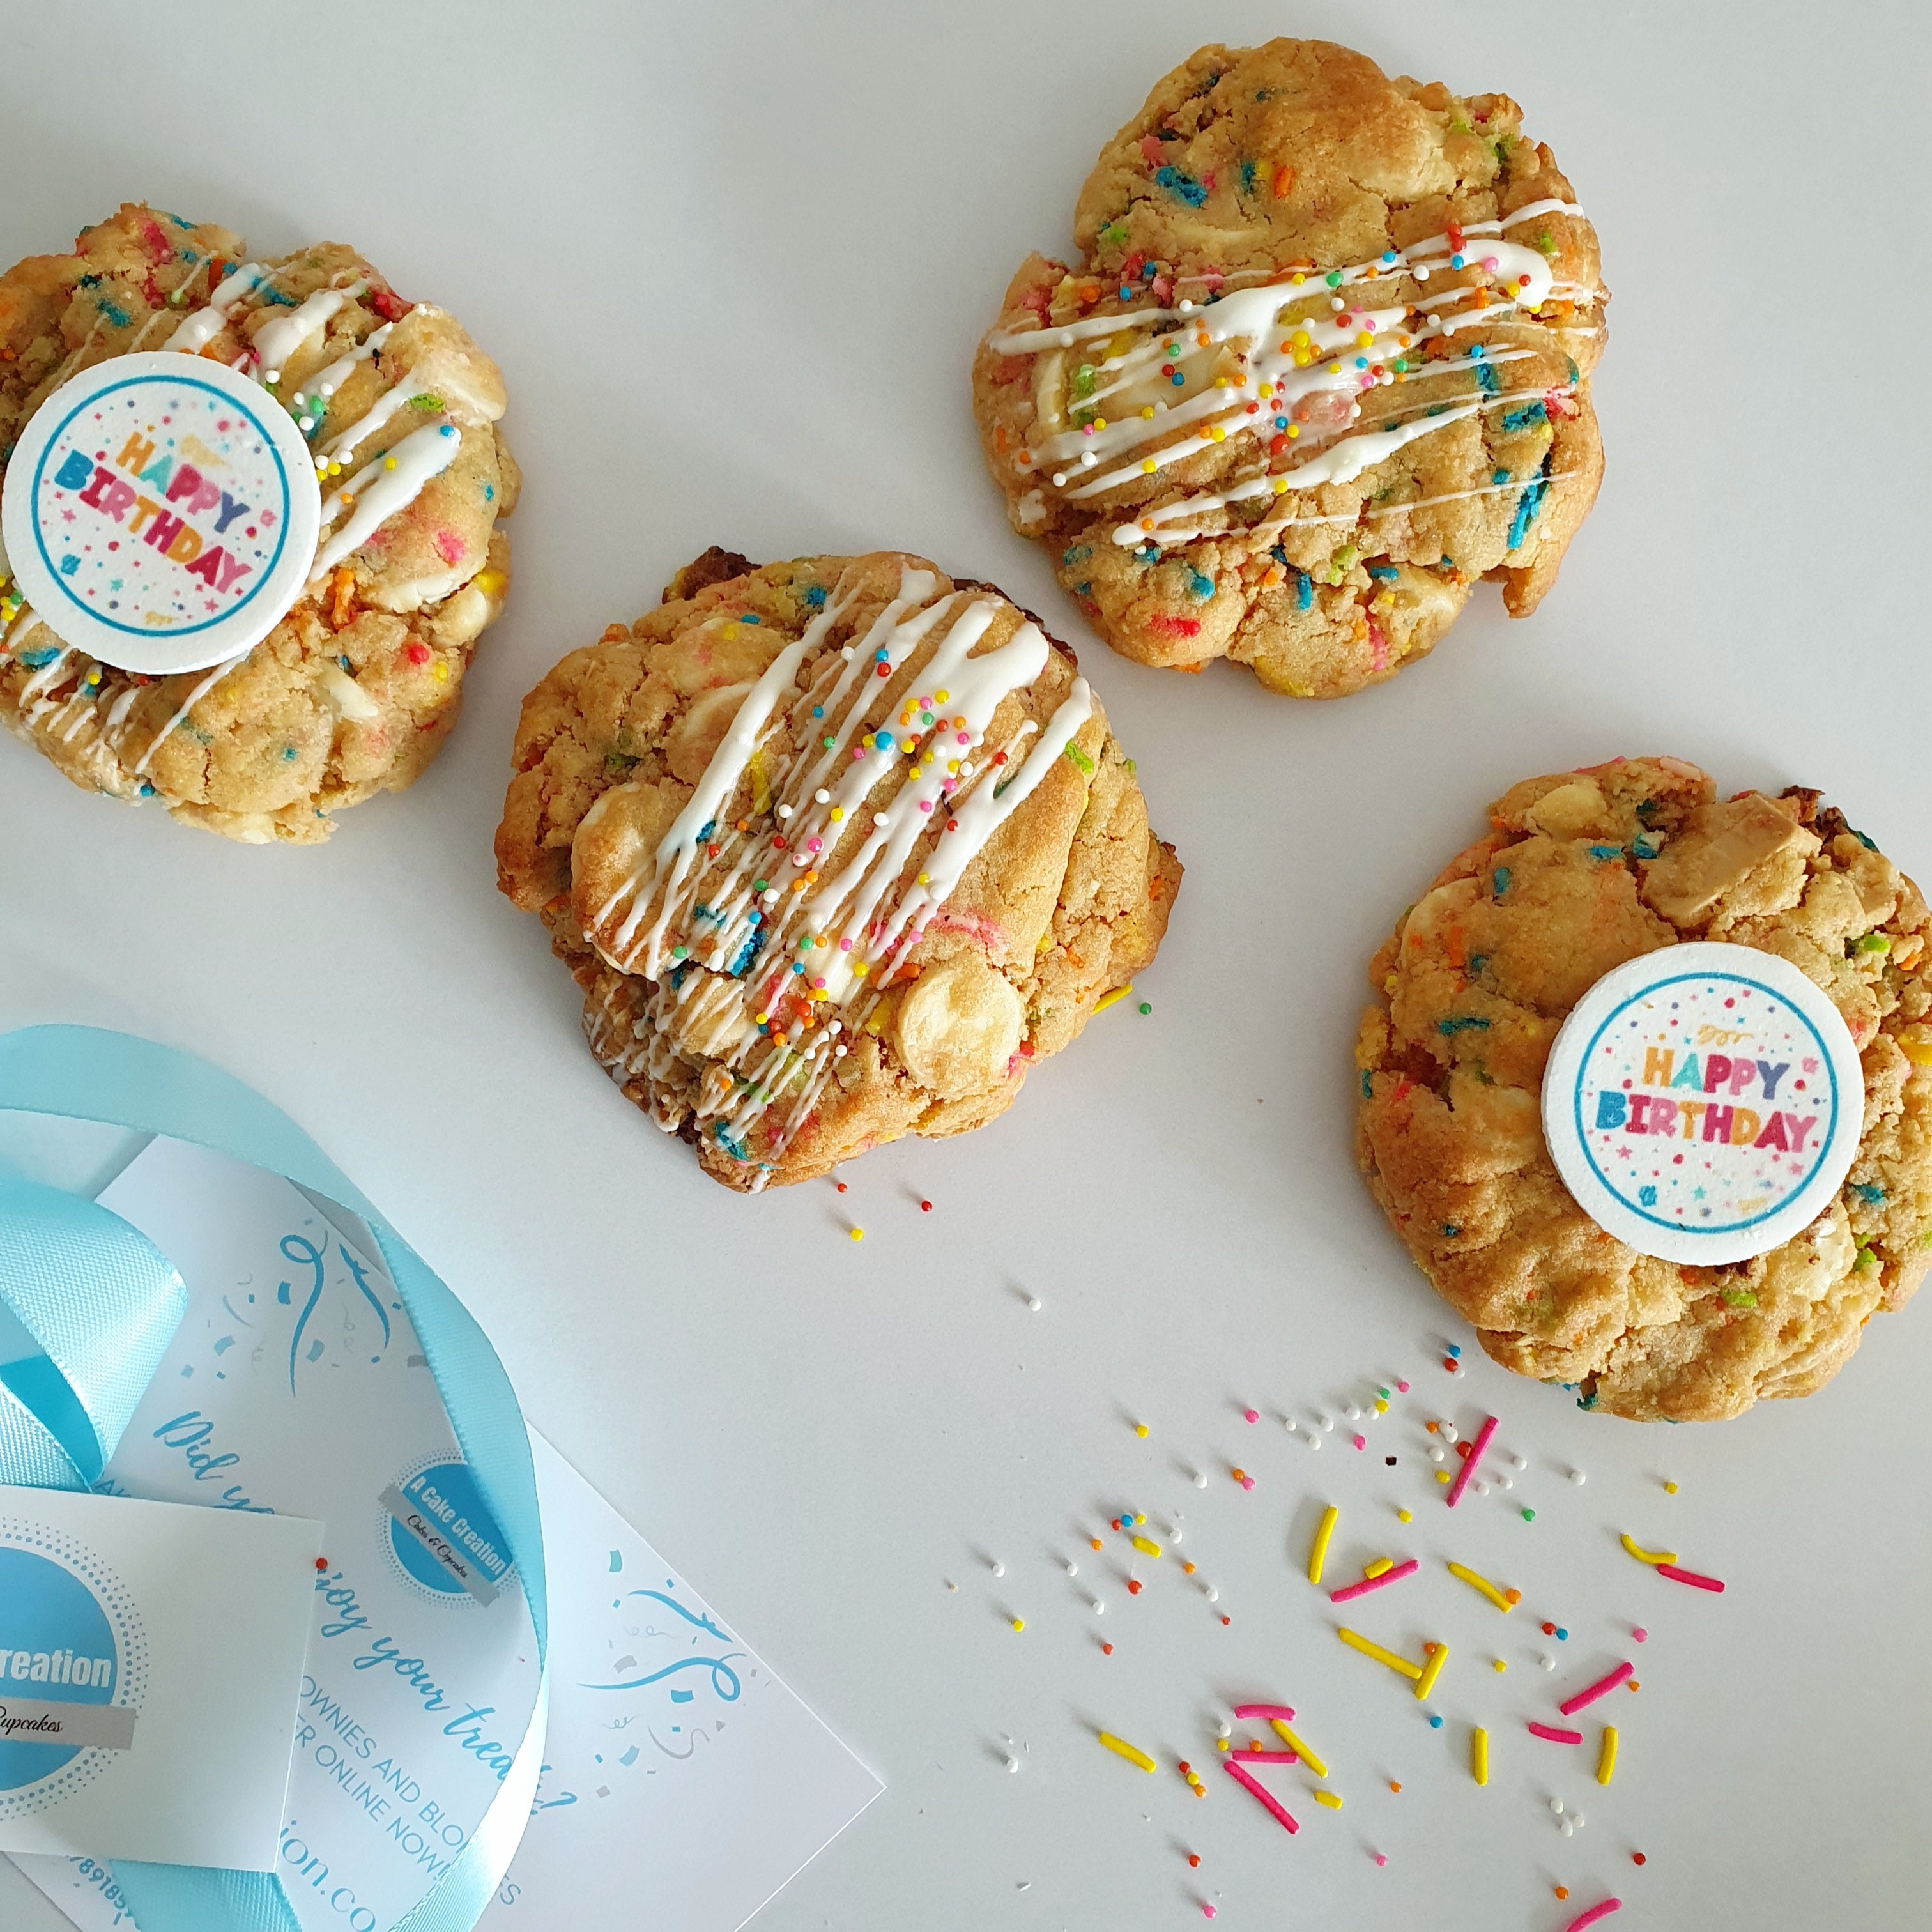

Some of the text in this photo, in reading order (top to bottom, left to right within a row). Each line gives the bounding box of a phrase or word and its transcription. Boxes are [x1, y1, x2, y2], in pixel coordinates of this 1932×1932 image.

[116, 432, 250, 533] HAPPY
[54, 449, 253, 594] BIRTHDAY
[1642, 1046, 1790, 1100] HAPPY
[1595, 1090, 1818, 1153] BIRTHDAY
[153, 1411, 240, 1481] Did
[410, 1476, 507, 1575] A Cake Creation
[353, 1636, 450, 1712] your
[315, 1744, 450, 1882] ONLINE NOW!
[371, 1758, 421, 1804] AND
